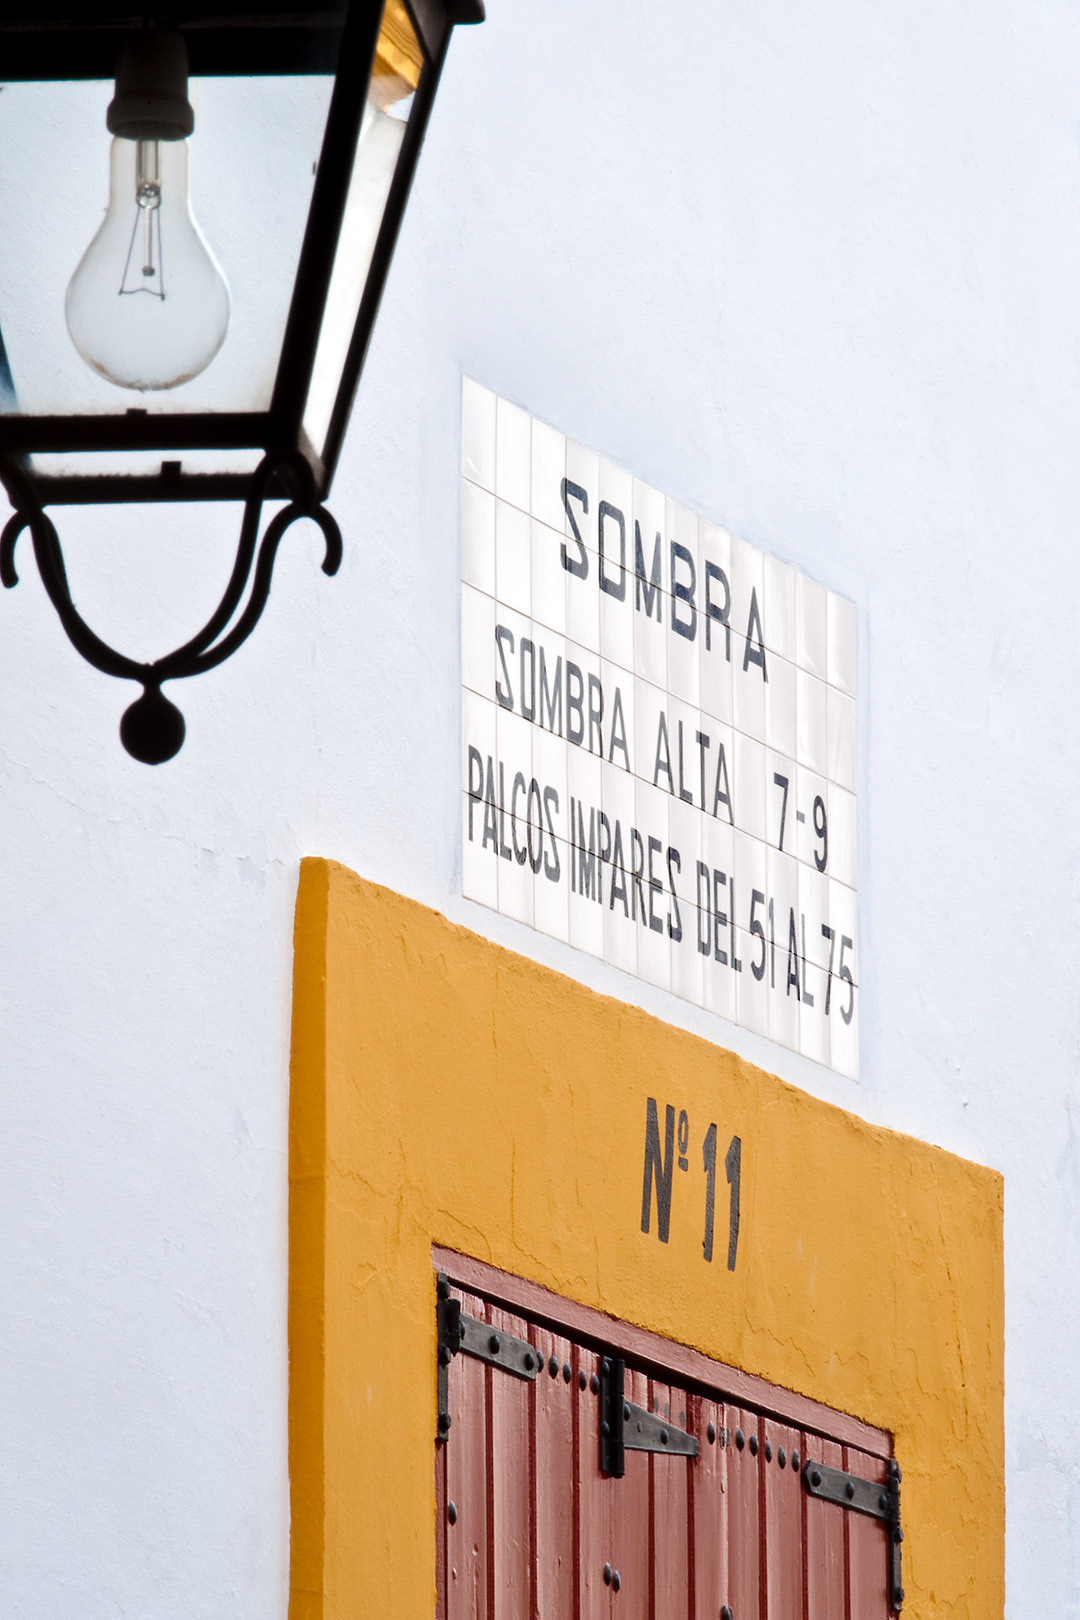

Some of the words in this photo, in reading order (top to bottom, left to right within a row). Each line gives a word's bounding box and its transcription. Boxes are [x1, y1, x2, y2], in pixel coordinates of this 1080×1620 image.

[560, 476, 769, 684] SOMBRA
[495, 623, 630, 773] SOMBRA
[653, 710, 734, 827] ALTA
[468, 744, 562, 883] PALCOS
[570, 796, 683, 944] IMPARES
[696, 859, 742, 973] DEL
[749, 888, 776, 990] 51
[786, 906, 815, 1009] AL
[821, 923, 855, 1026] 75
[701, 1122, 743, 1272] 11
